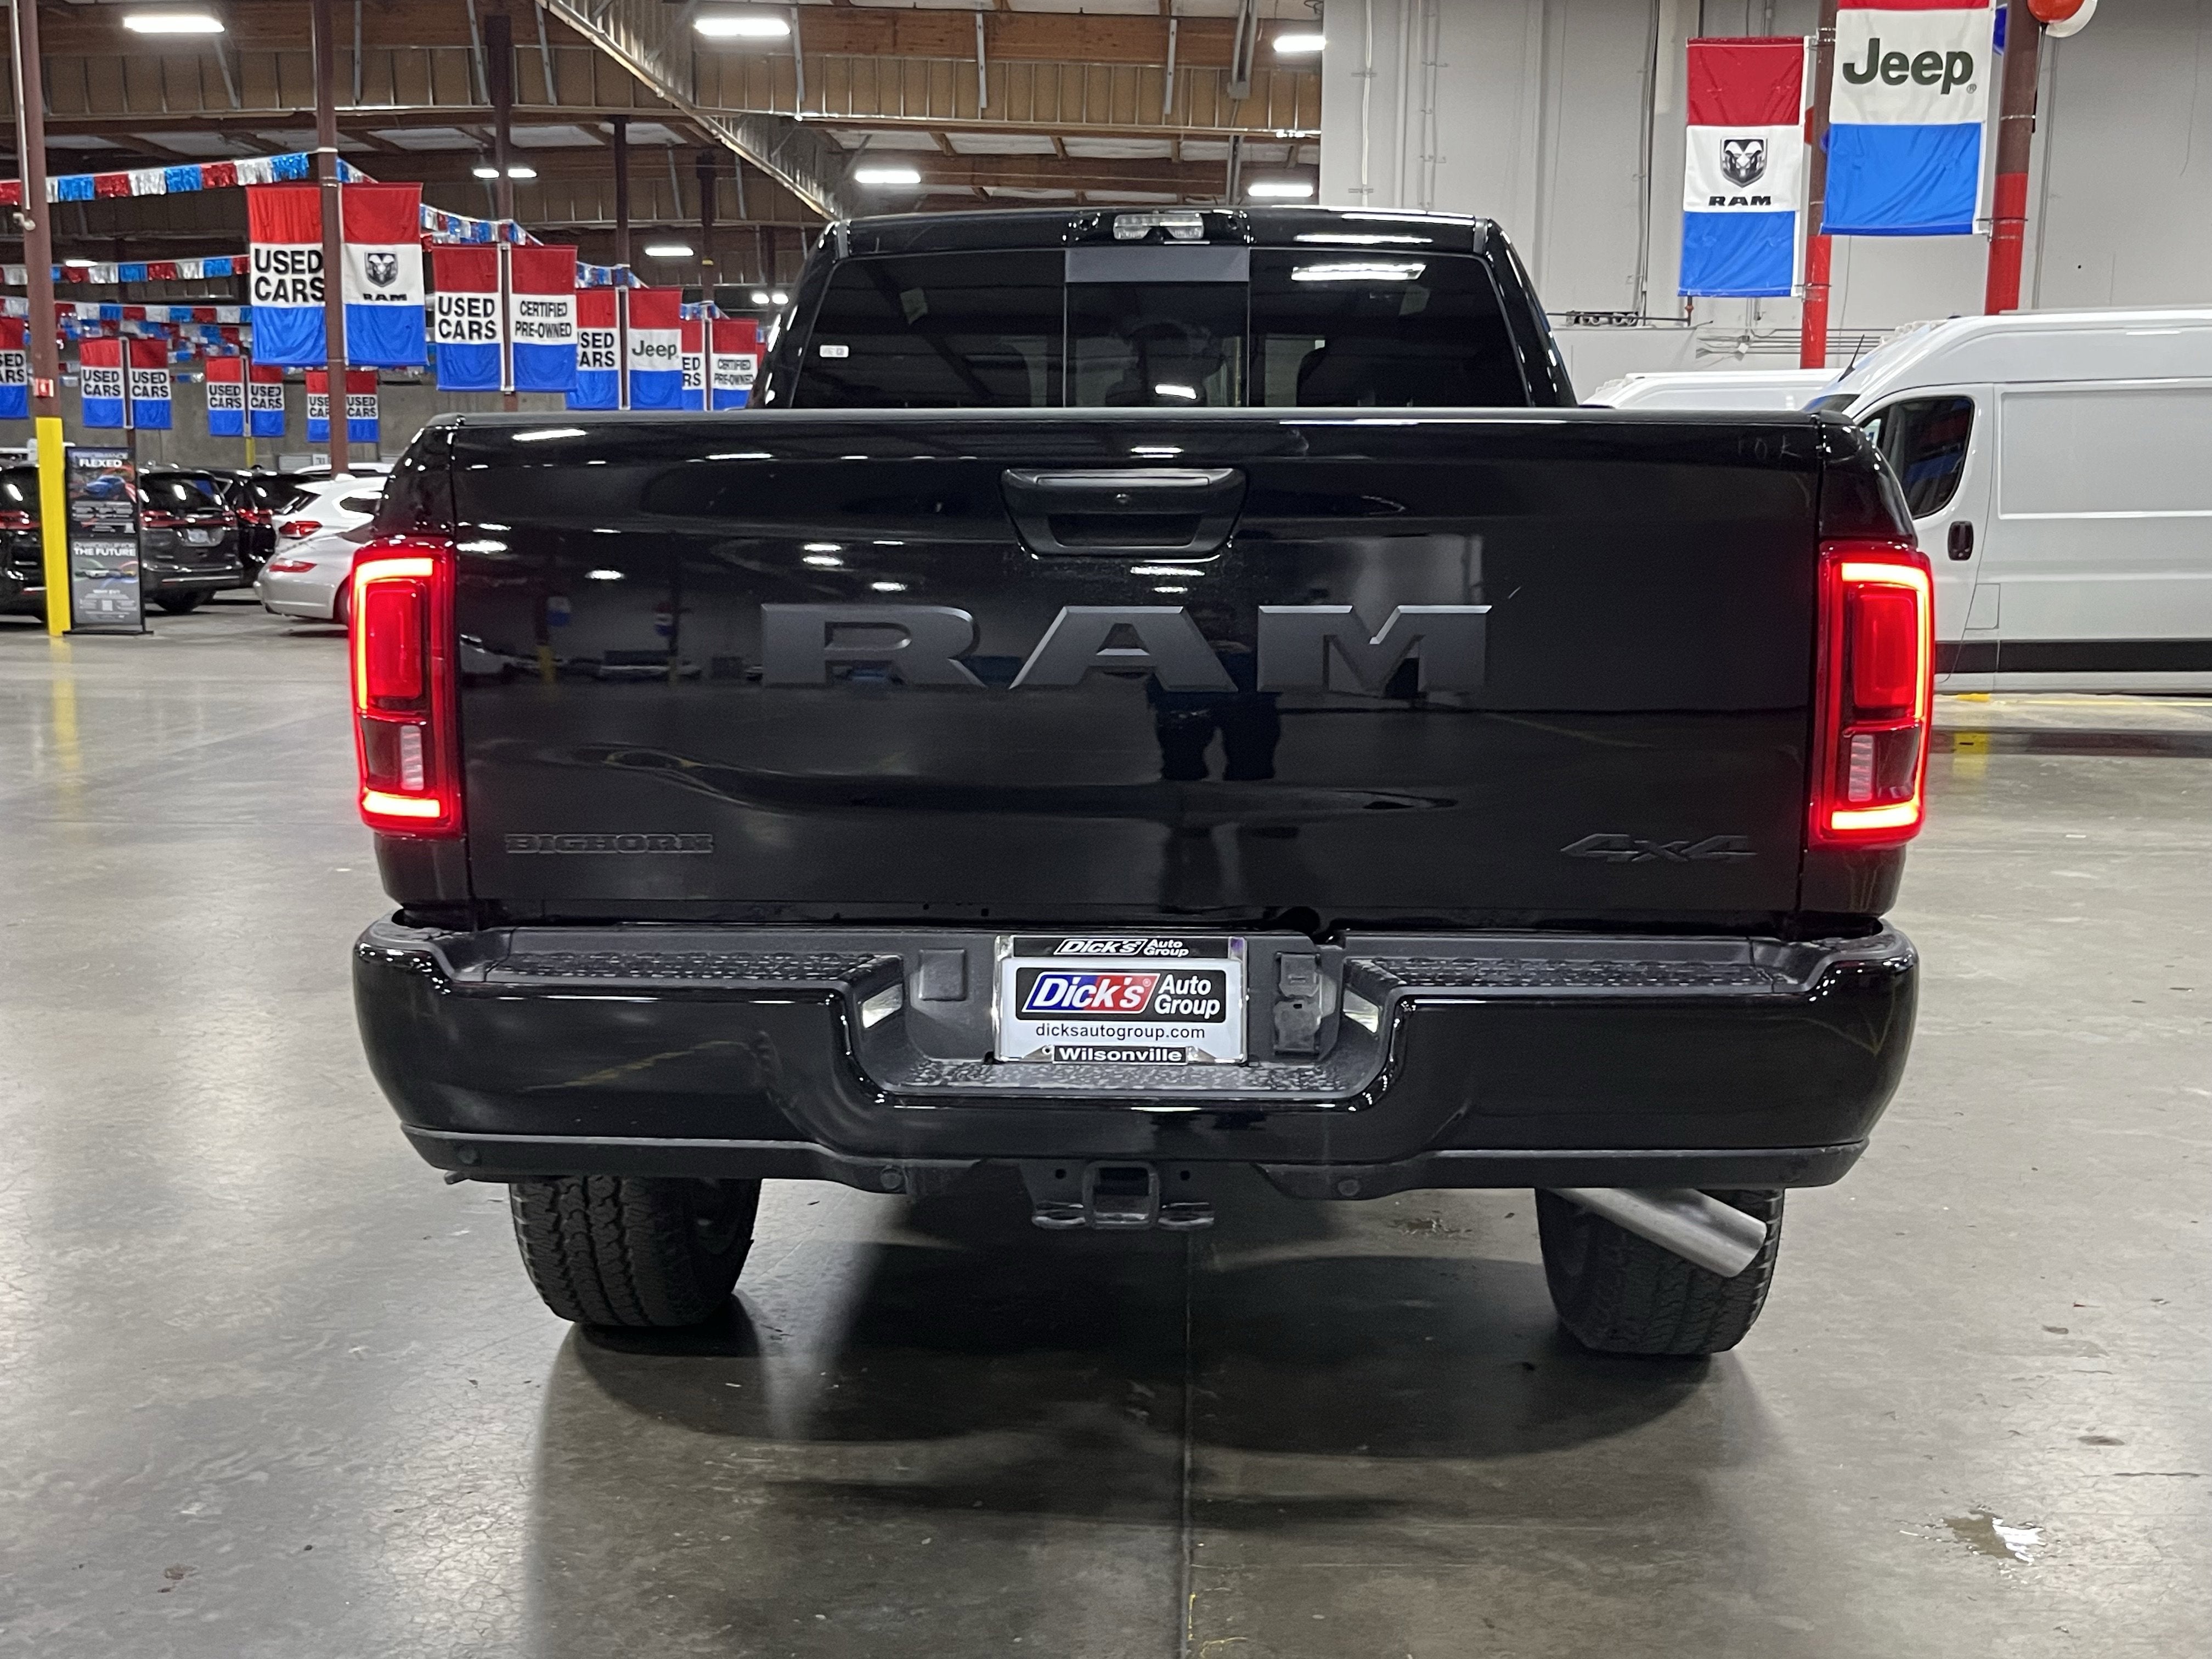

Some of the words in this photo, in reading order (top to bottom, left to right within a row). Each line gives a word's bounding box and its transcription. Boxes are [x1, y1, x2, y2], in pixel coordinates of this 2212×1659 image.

[1842, 38, 1973, 94] Jeep
[1708, 195, 1771, 207] RAM
[255, 249, 323, 274] USED
[255, 276, 324, 302] CARS
[438, 296, 495, 318] USED
[520, 301, 567, 317] CERTIFIED
[438, 319, 496, 340] CARS
[515, 321, 572, 338] PRE-OWNED
[578, 331, 614, 348] SED
[632, 340, 677, 360] Jeep
[0, 353, 24, 367] ED
[579, 351, 615, 367] ARS
[682, 357, 700, 370] ED
[83, 369, 119, 383] USED
[132, 371, 166, 384] USED
[682, 373, 701, 386] RS
[83, 383, 121, 396] CARS
[132, 385, 168, 397] CARS
[209, 385, 241, 396] USED
[251, 385, 281, 397] USED
[210, 397, 242, 408] CARS
[251, 397, 282, 408] CARS
[309, 396, 329, 406] USE
[347, 396, 376, 406] USED
[347, 408, 376, 417] CARS
[78, 459, 123, 468] FLEXED
[74, 548, 94, 556] THE
[95, 548, 136, 556] FUTURE
[761, 602, 1492, 693] RAM
[1148, 939, 1183, 949] Auto
[1144, 947, 1189, 957] Group
[1158, 974, 1212, 995] Auto
[1032, 976, 1143, 1009] Dick's
[1154, 997, 1221, 1019] Group
[1036, 1023, 1205, 1041] dicksautogroup.com
[1059, 1047, 1182, 1062] Wilsonville
